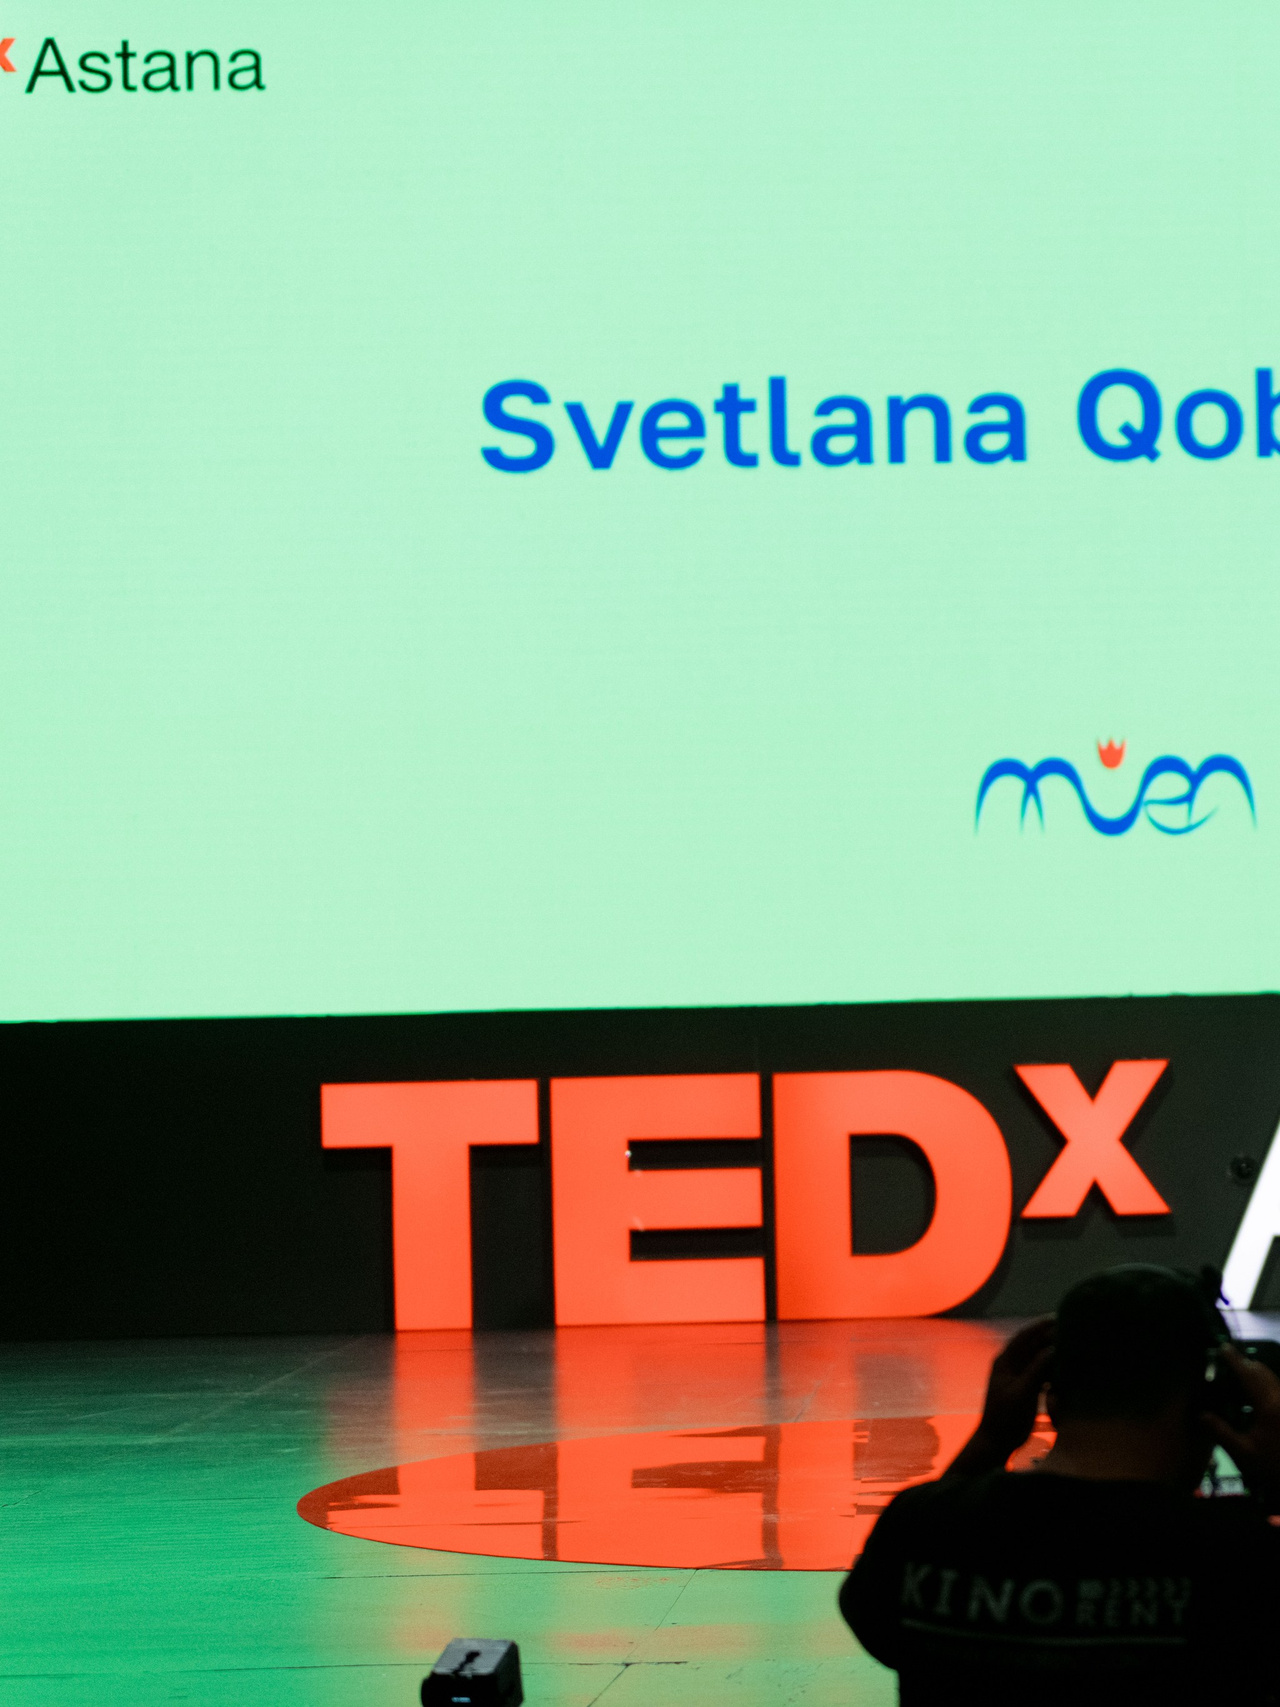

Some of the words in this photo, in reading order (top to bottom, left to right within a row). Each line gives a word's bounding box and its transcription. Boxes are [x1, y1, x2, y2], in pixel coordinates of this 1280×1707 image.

[25, 37, 267, 94] Astana
[480, 375, 1030, 477] Svetlana
[321, 1059, 1171, 1330] TEDx
[900, 1561, 1065, 1625] KINO
